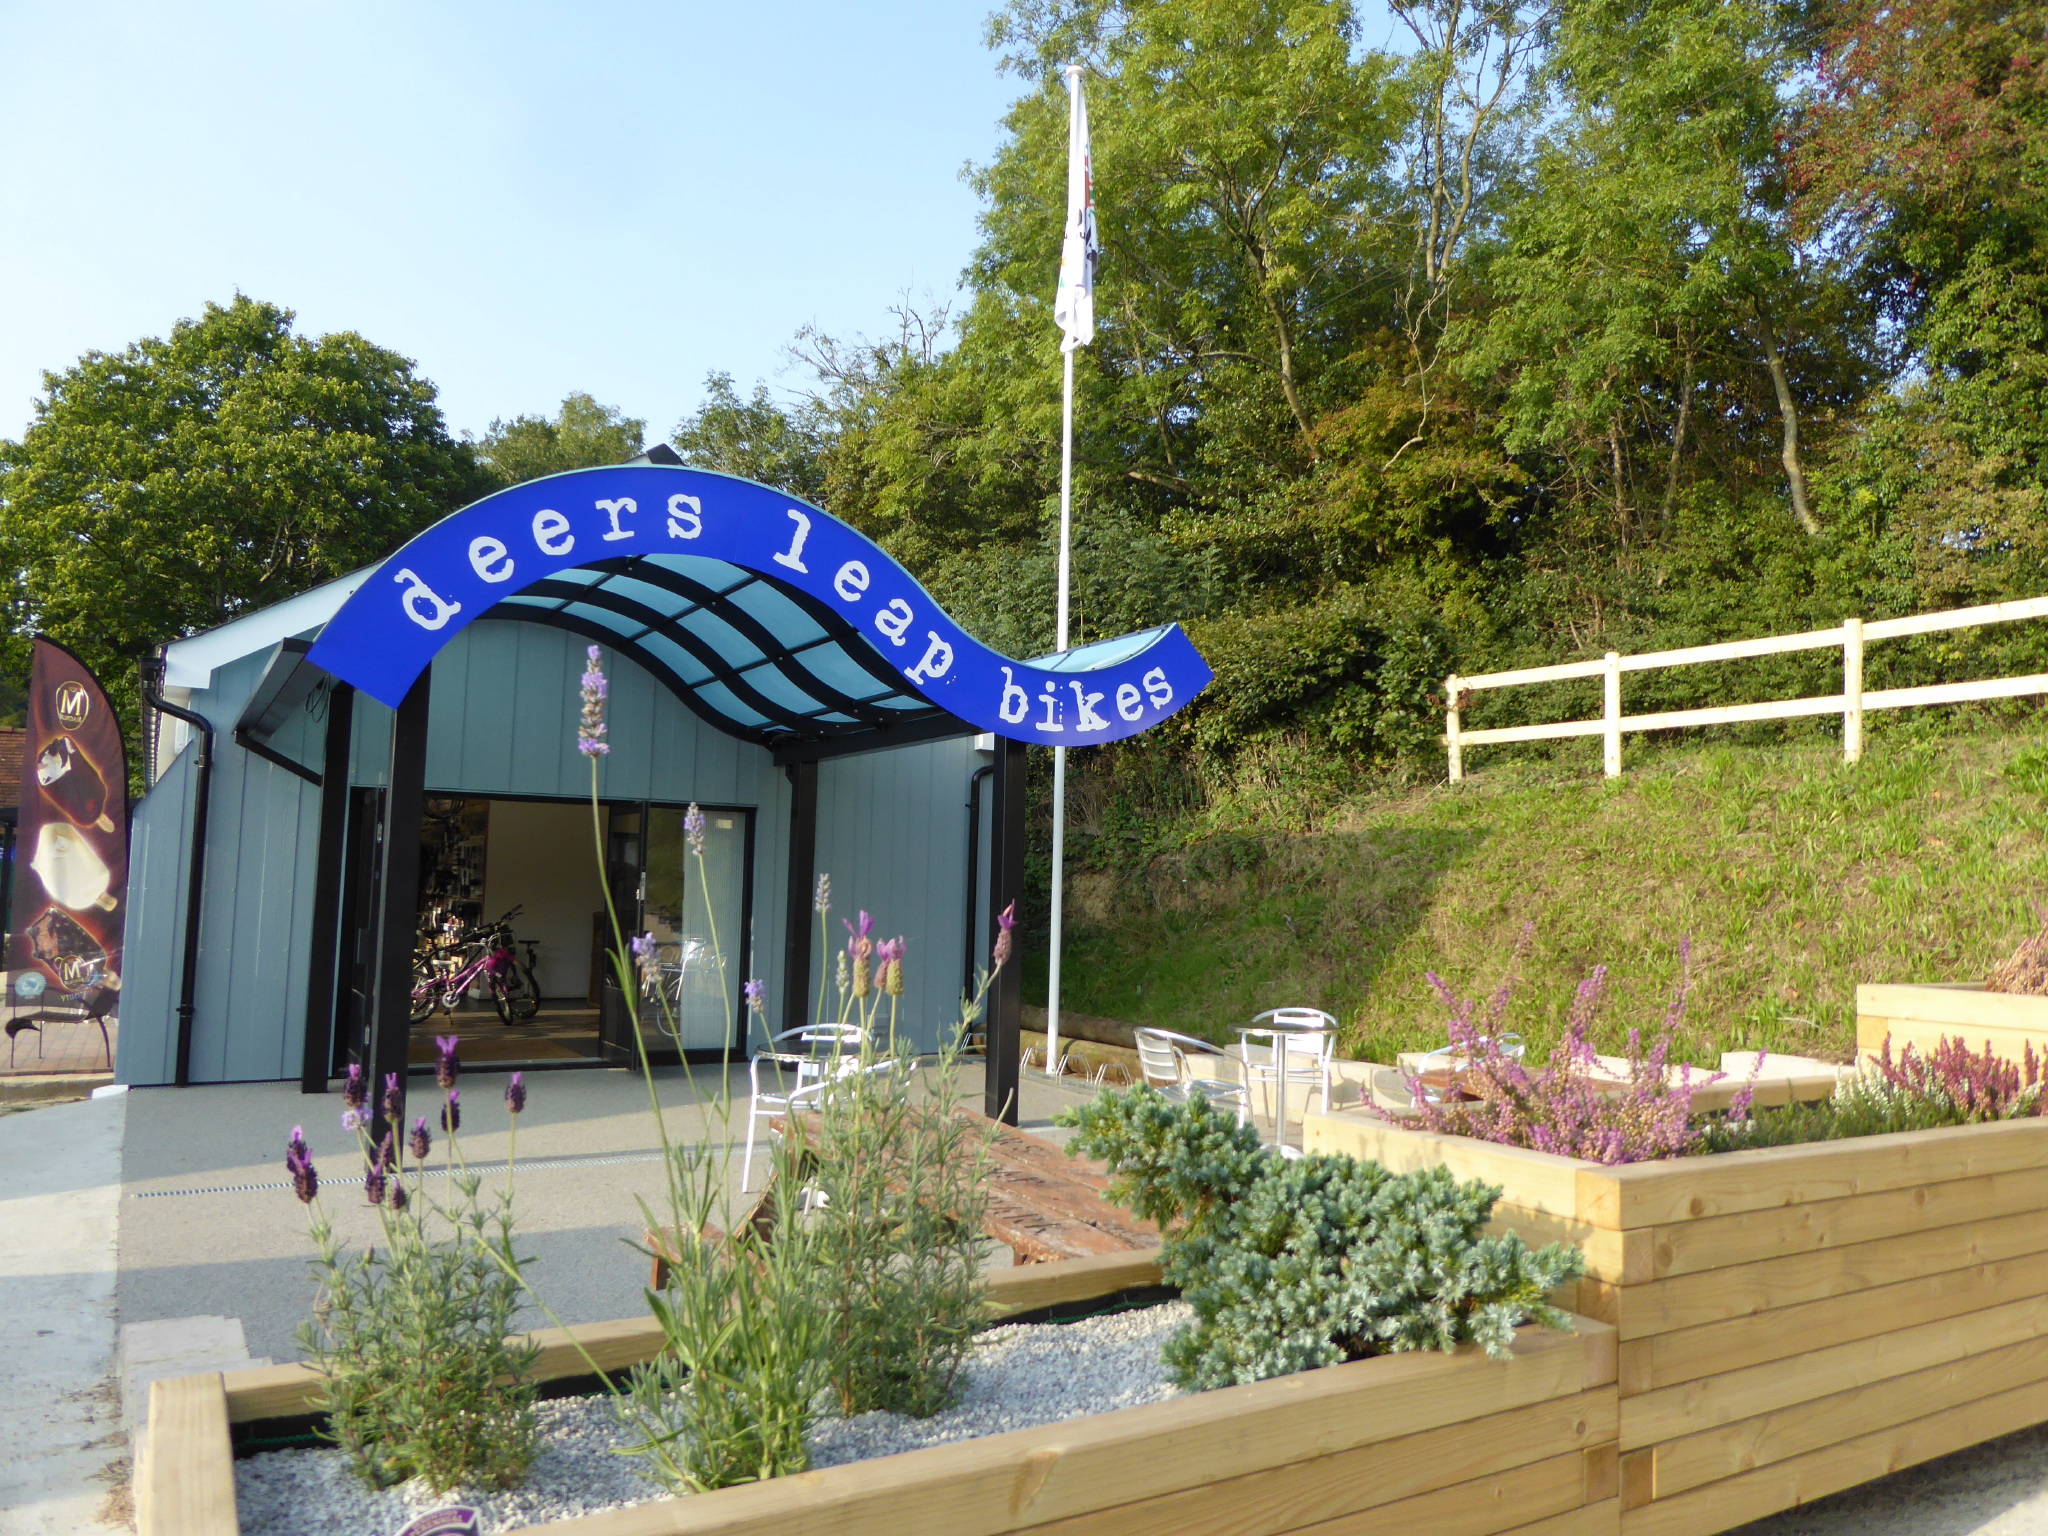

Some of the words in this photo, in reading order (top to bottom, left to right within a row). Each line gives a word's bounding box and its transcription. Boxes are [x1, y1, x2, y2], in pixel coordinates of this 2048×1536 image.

[394, 494, 703, 631] deers
[772, 509, 955, 685] leap
[999, 666, 1174, 732] bikes
